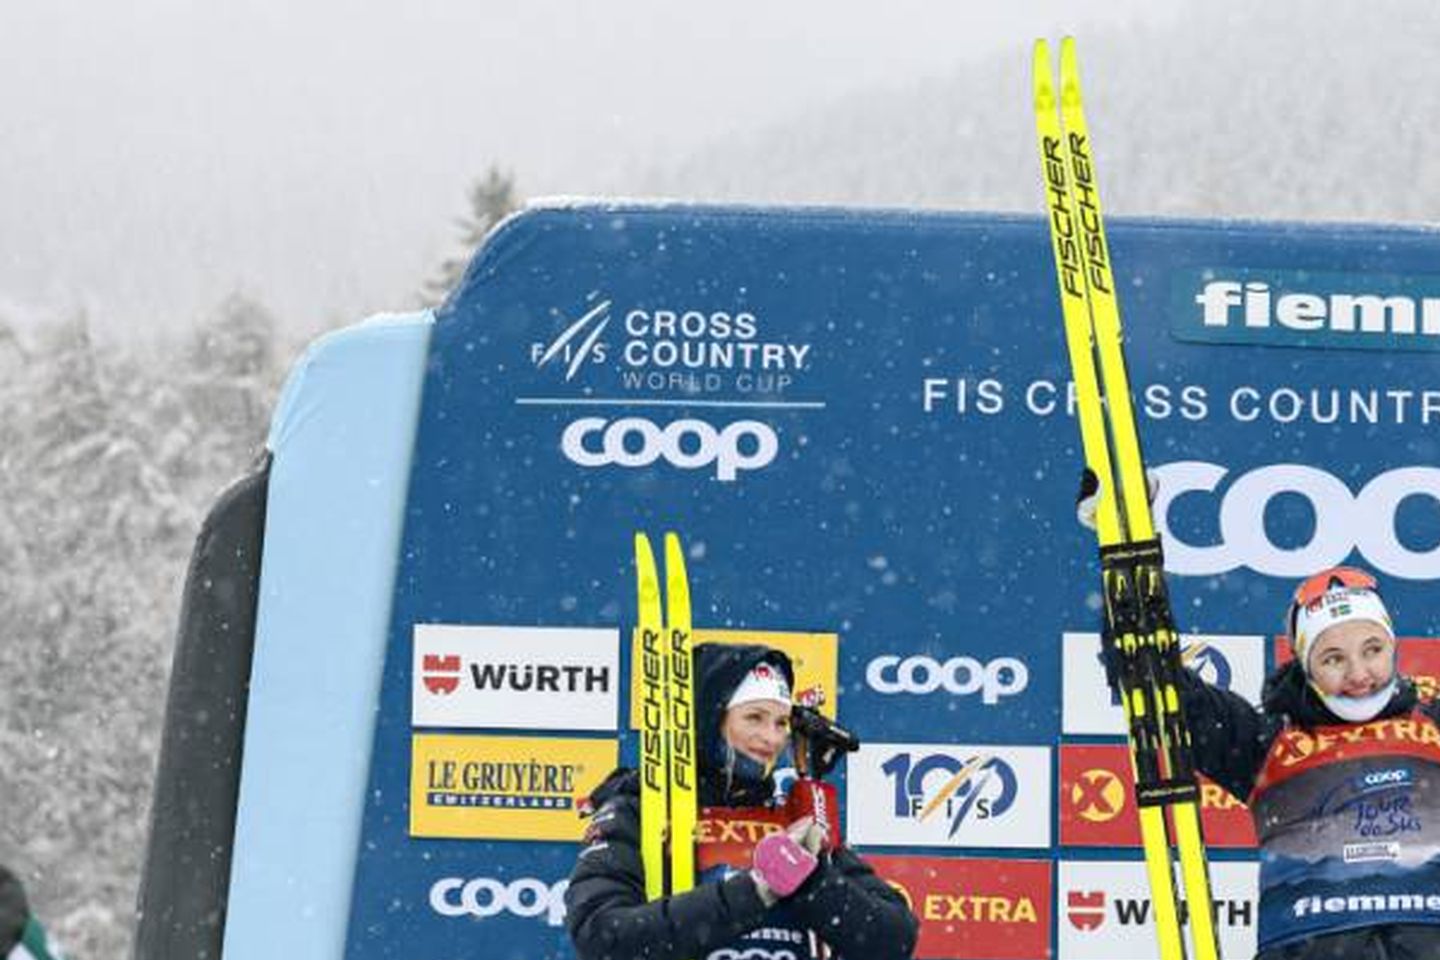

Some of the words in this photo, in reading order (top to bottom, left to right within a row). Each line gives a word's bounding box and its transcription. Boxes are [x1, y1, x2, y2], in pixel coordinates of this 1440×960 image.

[1043, 133, 1083, 298] FISCHER
[1069, 131, 1111, 294] FISCHER
[624, 310, 757, 339] CROSS
[624, 340, 811, 369] COUNTRY
[623, 371, 722, 391] WORLD
[735, 373, 793, 393] CUP
[923, 378, 1004, 414] FIS
[1025, 379, 1209, 421] CSS
[561, 417, 779, 480] coop
[470, 663, 610, 694] WÜRTH
[866, 655, 1029, 704] coop
[643, 629, 661, 792] FISCHER
[671, 628, 692, 791] FISCHER
[428, 759, 457, 790] LE
[462, 758, 576, 793] GRUYÈRE
[1364, 769, 1406, 784] coop
[924, 894, 1037, 922] EXTRA
